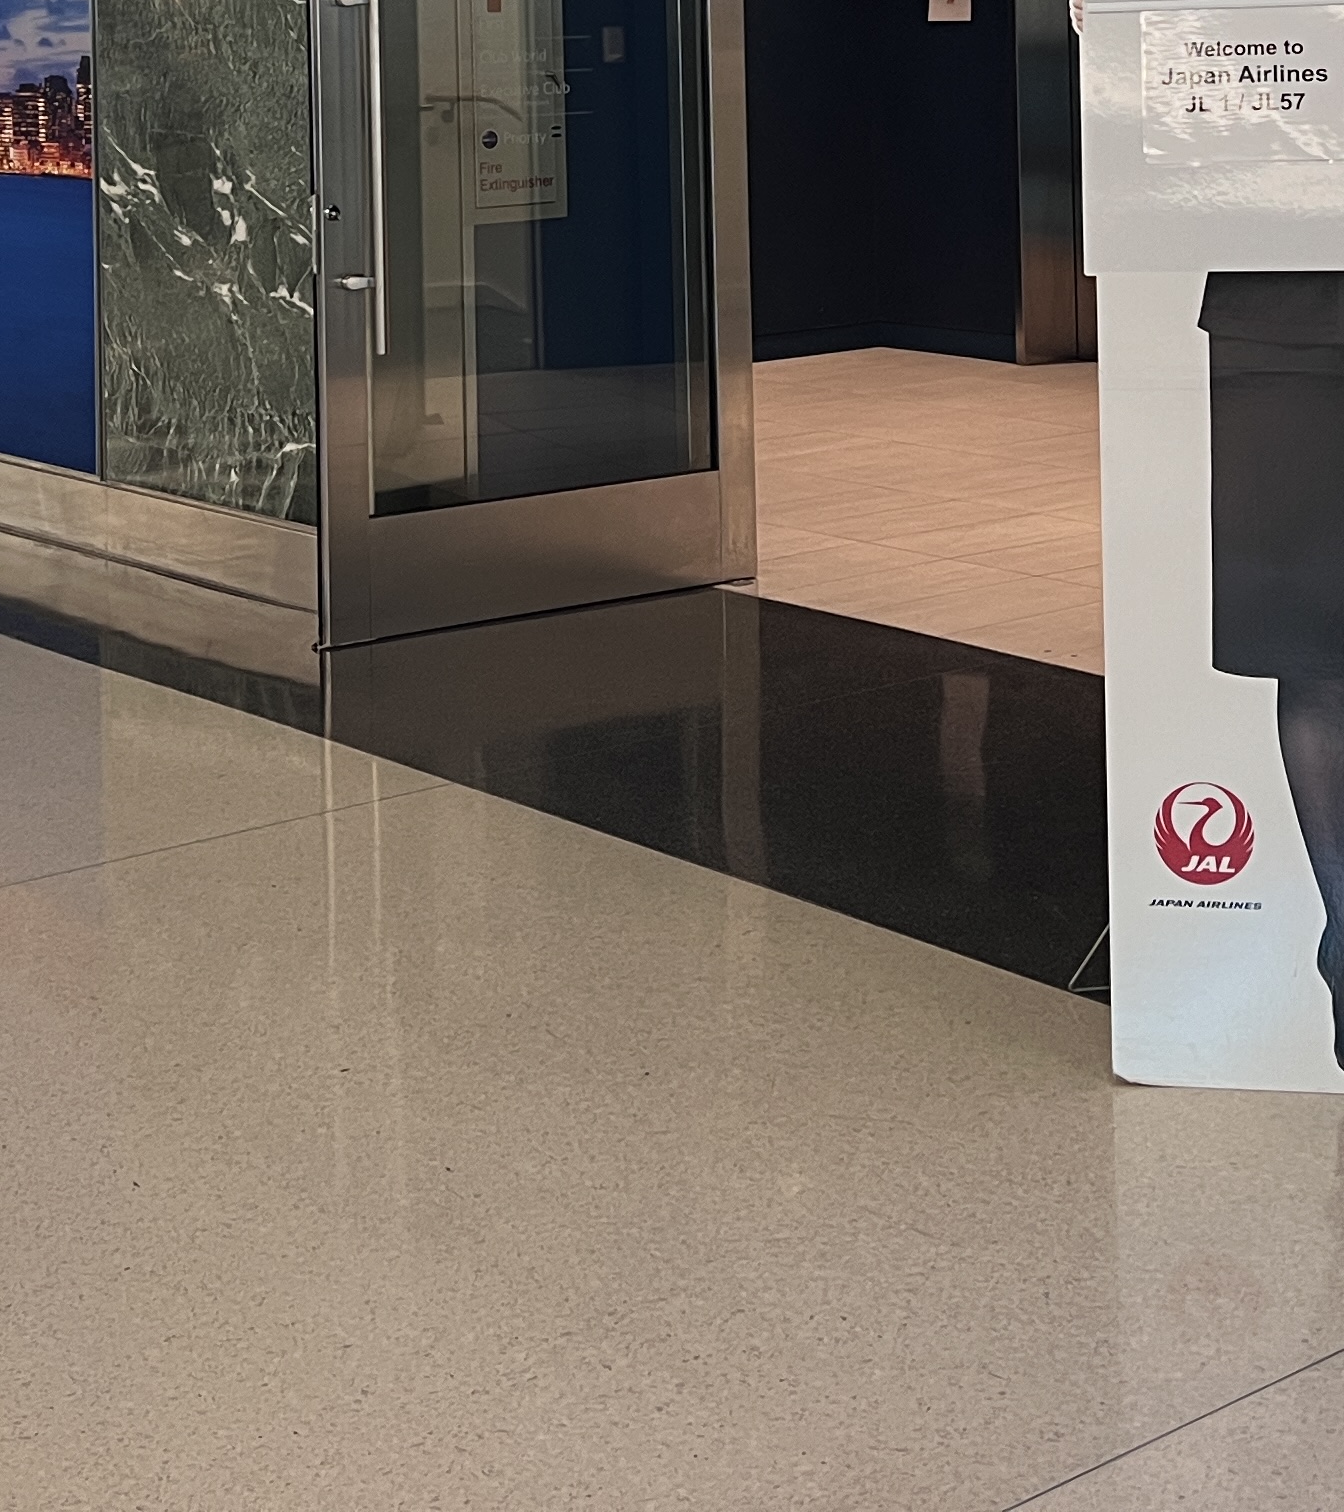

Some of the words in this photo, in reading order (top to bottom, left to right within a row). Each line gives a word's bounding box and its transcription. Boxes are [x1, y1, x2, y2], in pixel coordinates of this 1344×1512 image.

[1184, 41, 1277, 57] Welcome
[1283, 39, 1304, 56] to
[1161, 66, 1231, 89] Japan
[1238, 64, 1328, 83] Airlines
[543, 79, 571, 95] Club
[1185, 95, 1212, 113] JL
[479, 161, 503, 175] Fire
[479, 175, 555, 192] Extinguisher
[1181, 855, 1235, 873] JAL
[1148, 899, 1194, 909] JAPAN
[1196, 900, 1262, 910] AIRLINES
